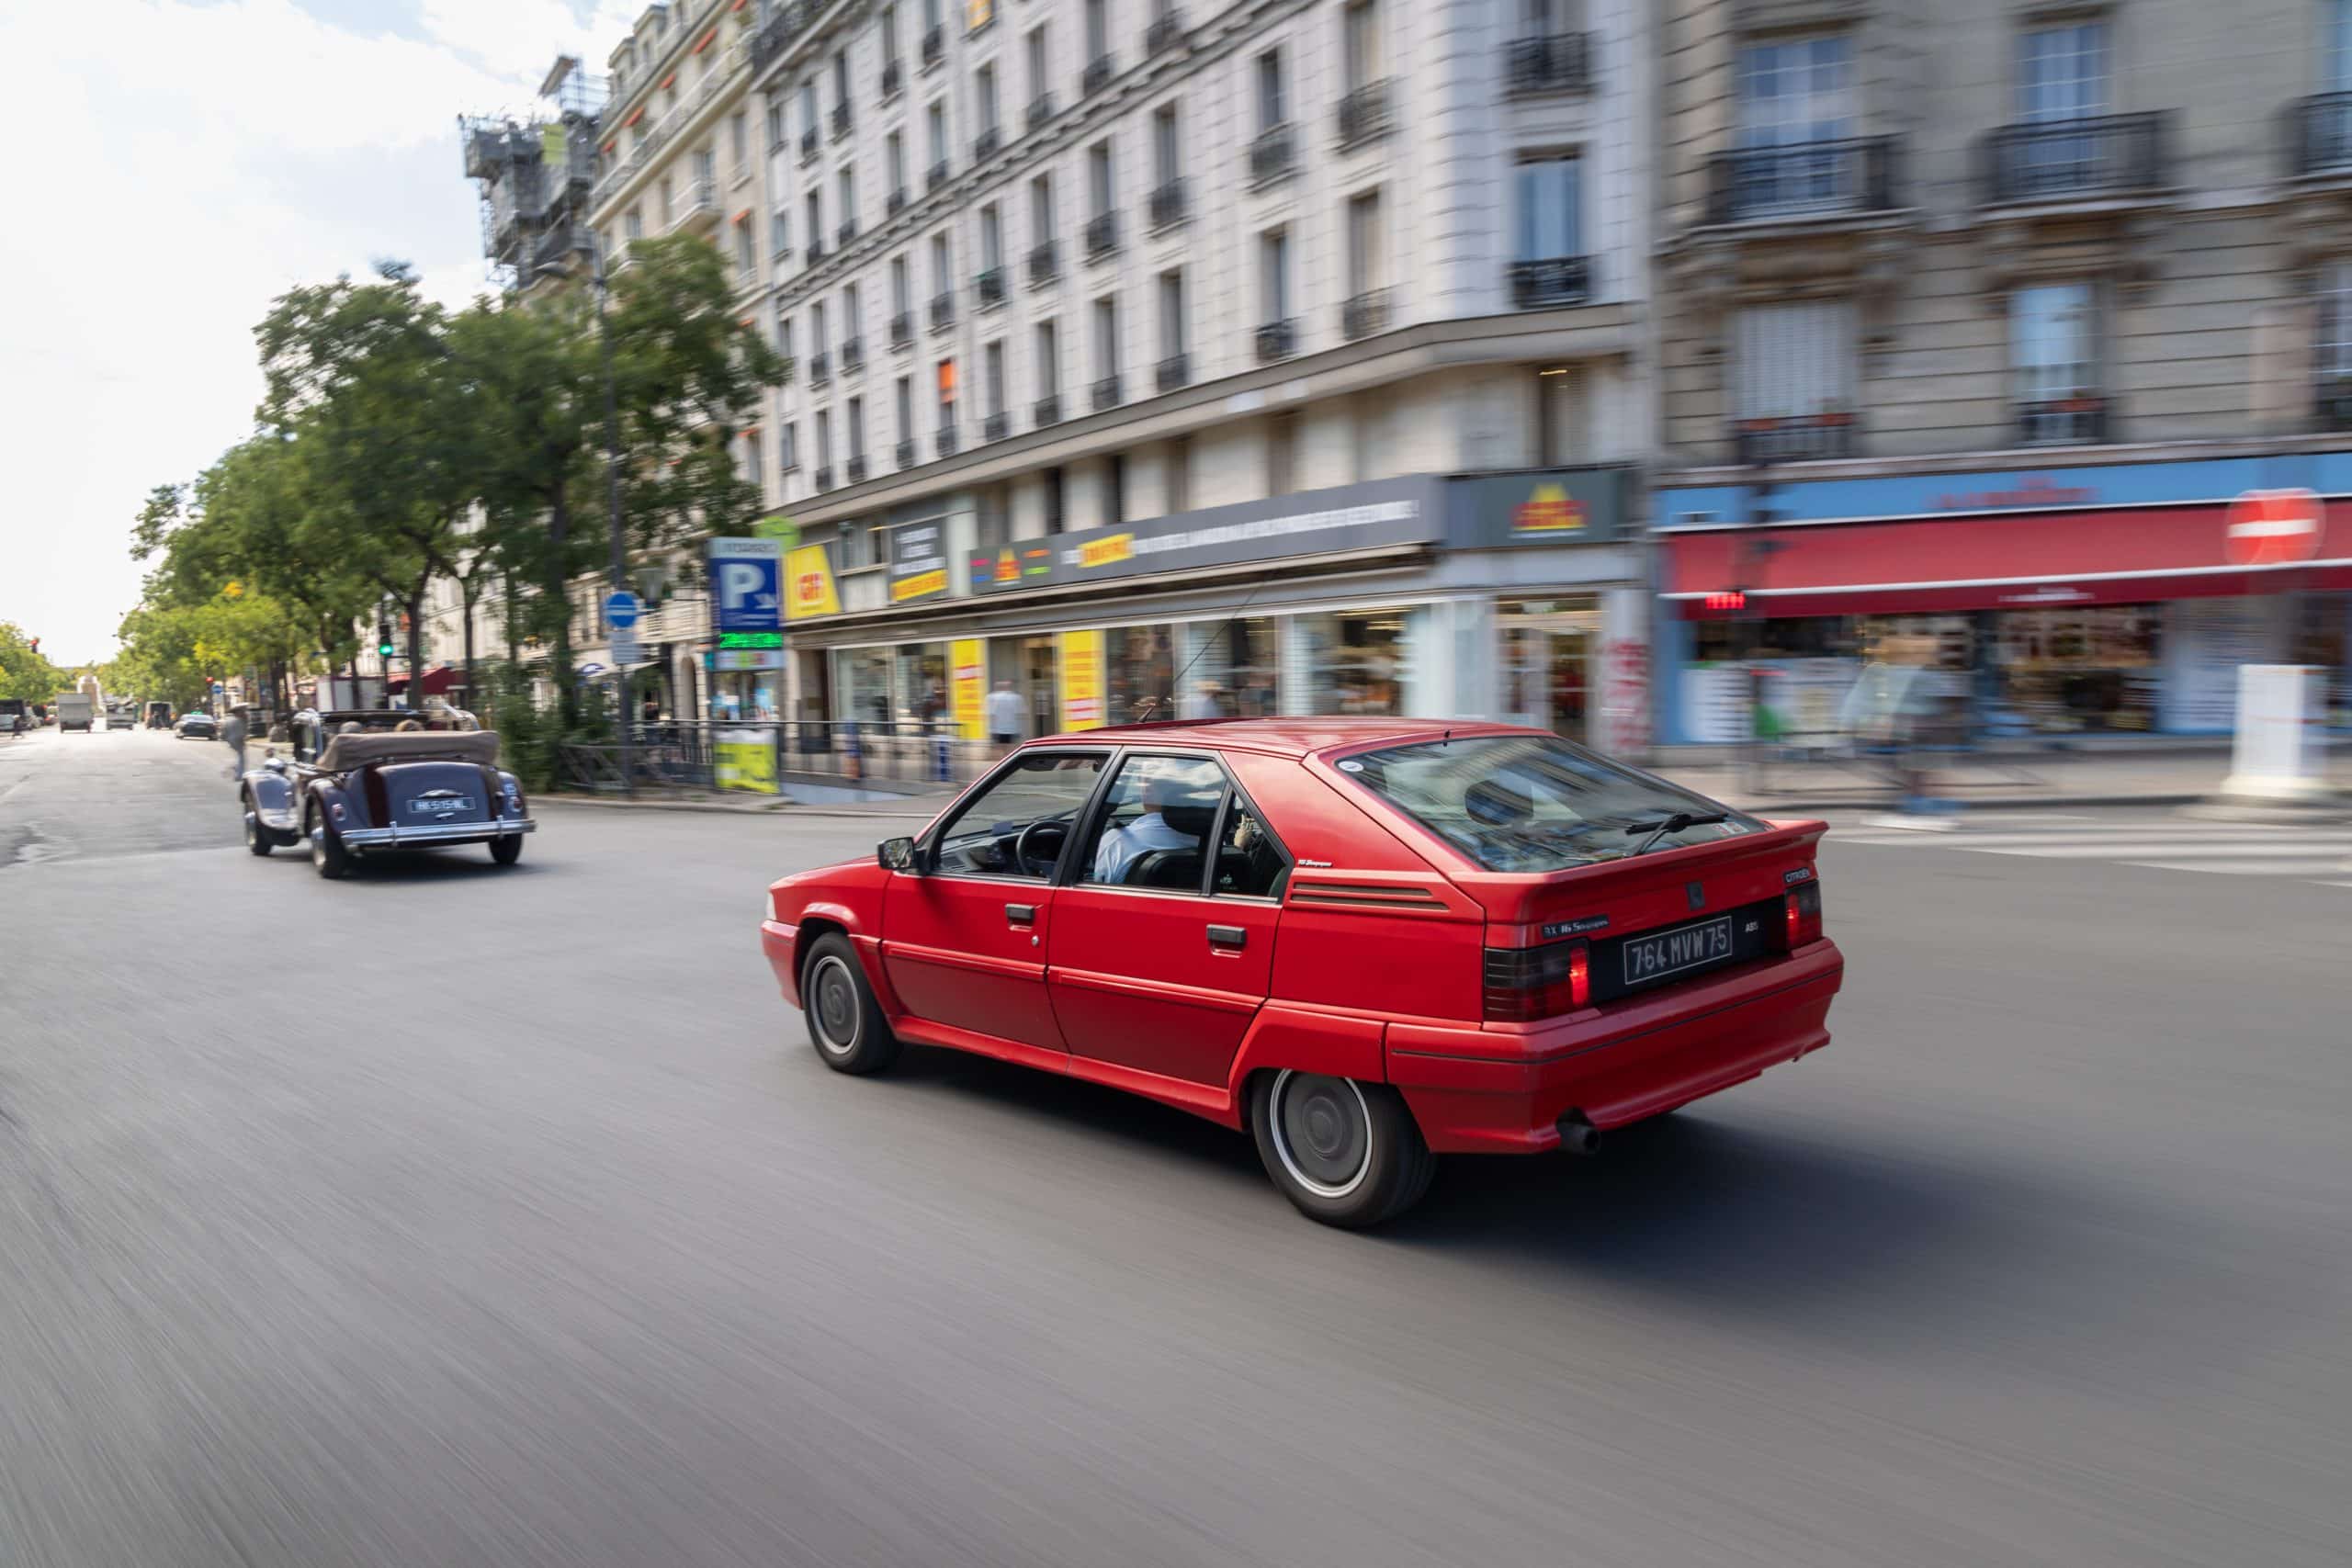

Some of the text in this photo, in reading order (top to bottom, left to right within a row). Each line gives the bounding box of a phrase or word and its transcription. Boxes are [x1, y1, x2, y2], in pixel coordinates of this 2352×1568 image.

[719, 563, 766, 609] P
[1631, 924, 1727, 976] 764 MVW 75
